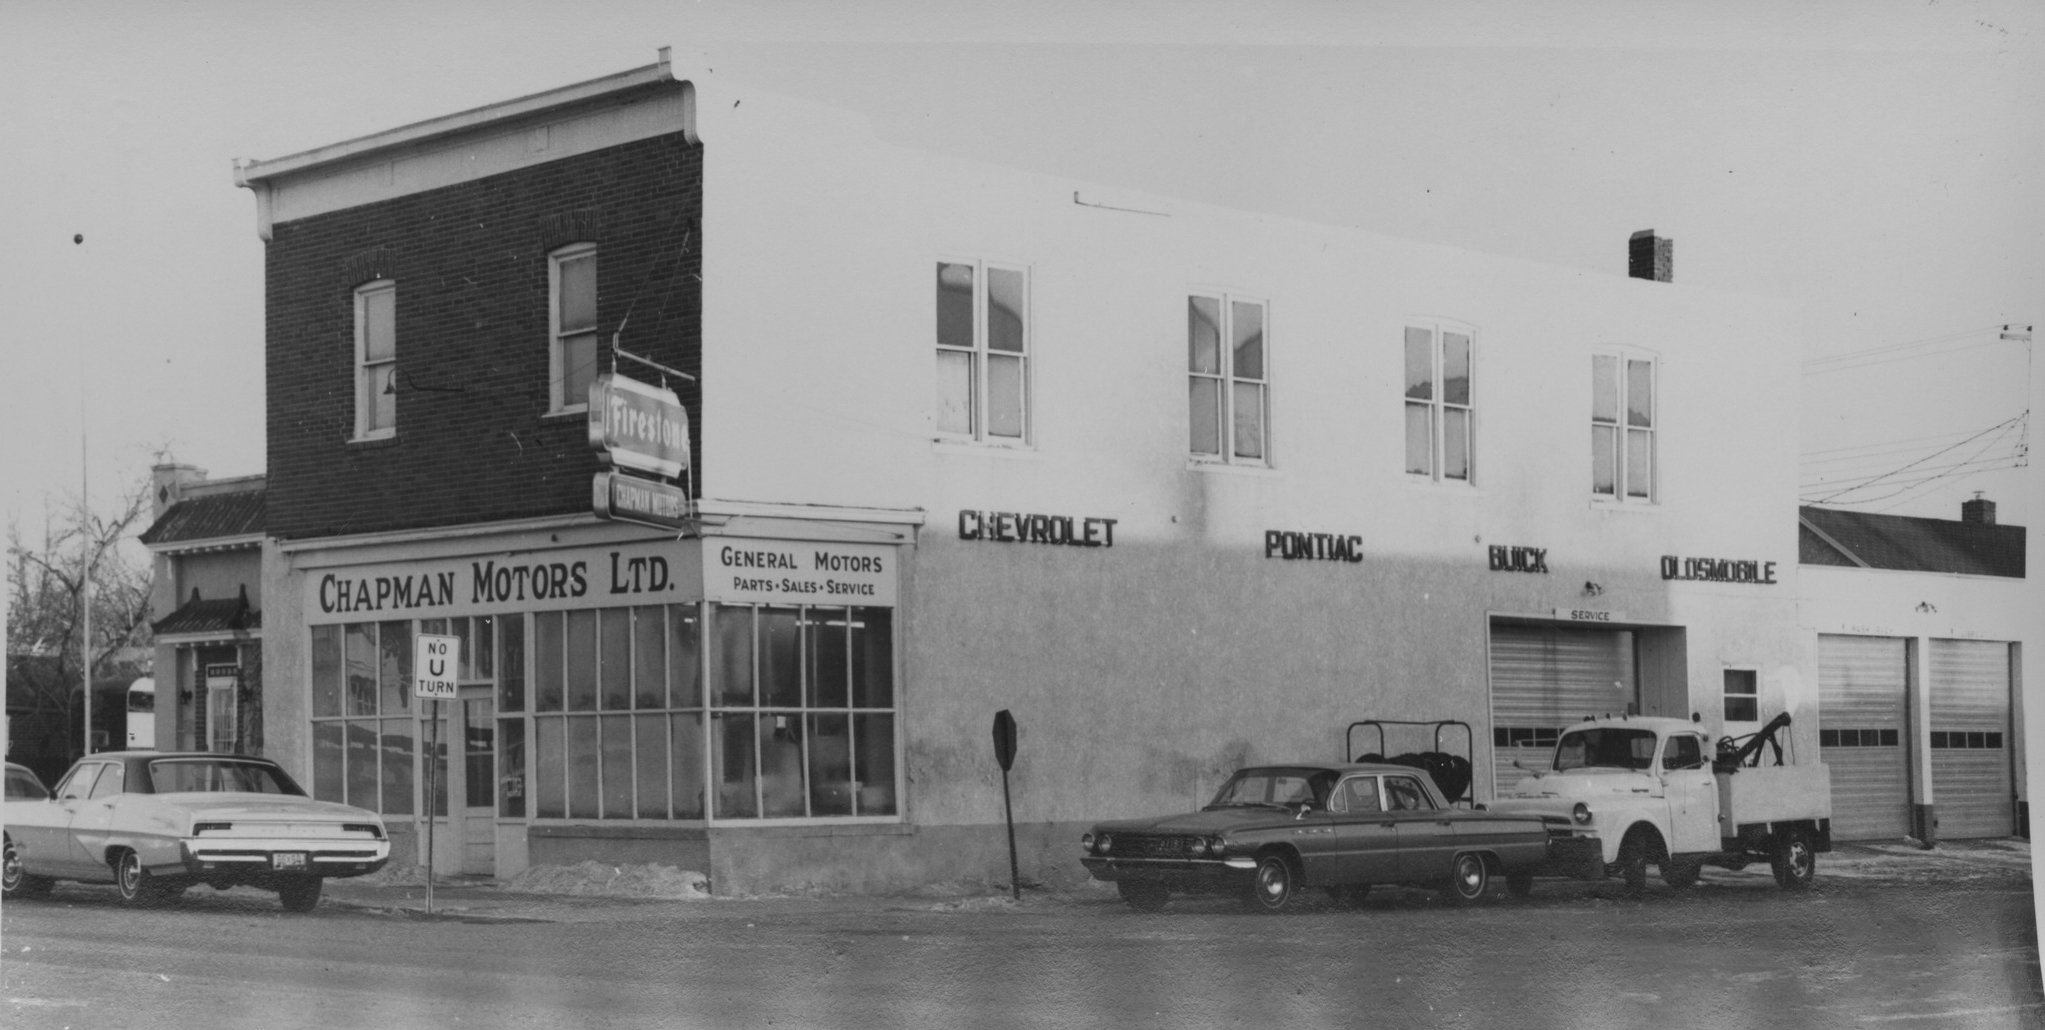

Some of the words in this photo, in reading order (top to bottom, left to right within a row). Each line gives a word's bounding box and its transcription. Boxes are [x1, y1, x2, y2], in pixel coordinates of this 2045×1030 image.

[610, 394, 690, 453] Firestone
[616, 483, 651, 513] CHAPMAN
[959, 509, 1118, 547] CHEVROLET
[721, 546, 797, 569] GENERAL
[815, 551, 882, 573] MOTORS
[1265, 530, 1363, 562] PONTIAC
[1488, 545, 1548, 574] BUICK
[320, 572, 455, 613] CHAPMAN
[472, 561, 587, 603] MOTORS
[610, 552, 675, 594] LTD.
[1660, 555, 1777, 584] OLDSMOBILE
[734, 577, 773, 592] PARTS
[781, 578, 817, 593] SALES
[827, 579, 875, 595] SERVICE
[1571, 609, 1610, 621] SERVICE
[428, 642, 447, 655] NO
[430, 659, 445, 676] U
[419, 680, 454, 694] TURN
